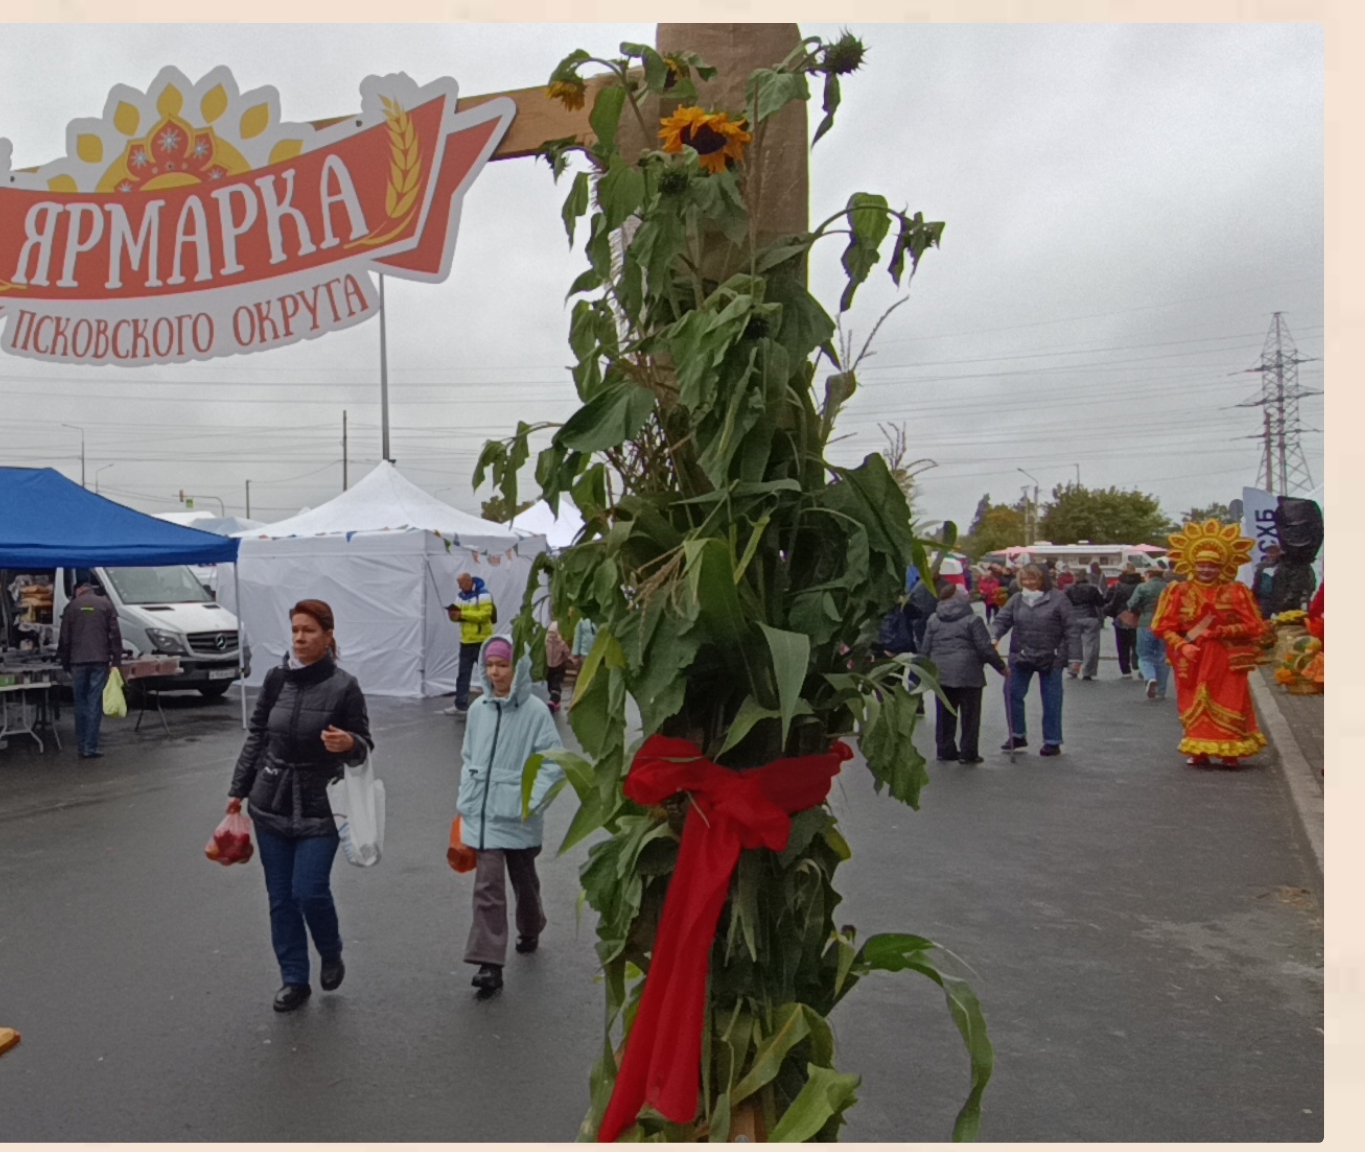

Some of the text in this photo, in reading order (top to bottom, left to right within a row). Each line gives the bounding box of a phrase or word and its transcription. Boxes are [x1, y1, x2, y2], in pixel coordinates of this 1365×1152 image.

[10, 153, 369, 289] ЯРМАРКА
[10, 273, 369, 360] ПСКОВСКОГО ОКРУГА
[1255, 509, 1279, 562] СХБ
